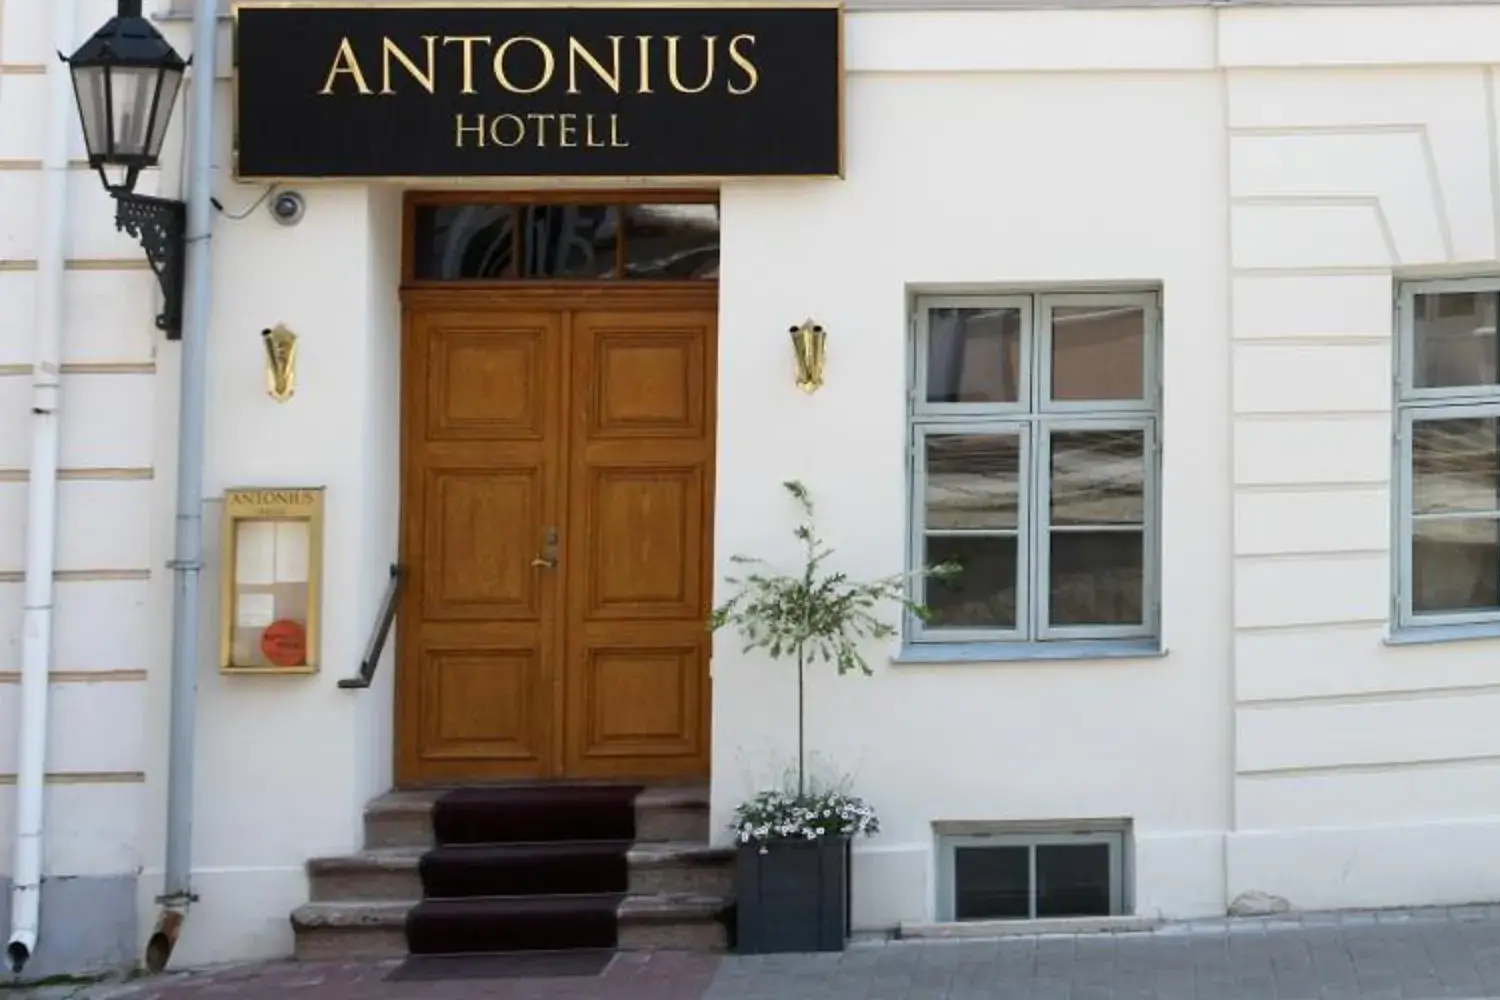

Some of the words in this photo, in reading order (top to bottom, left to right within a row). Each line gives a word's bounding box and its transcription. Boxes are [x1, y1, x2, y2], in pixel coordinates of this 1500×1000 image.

[319, 34, 758, 95] ANTONIUS
[455, 113, 629, 147] HOTELL
[230, 492, 317, 506] ANTONIUS
